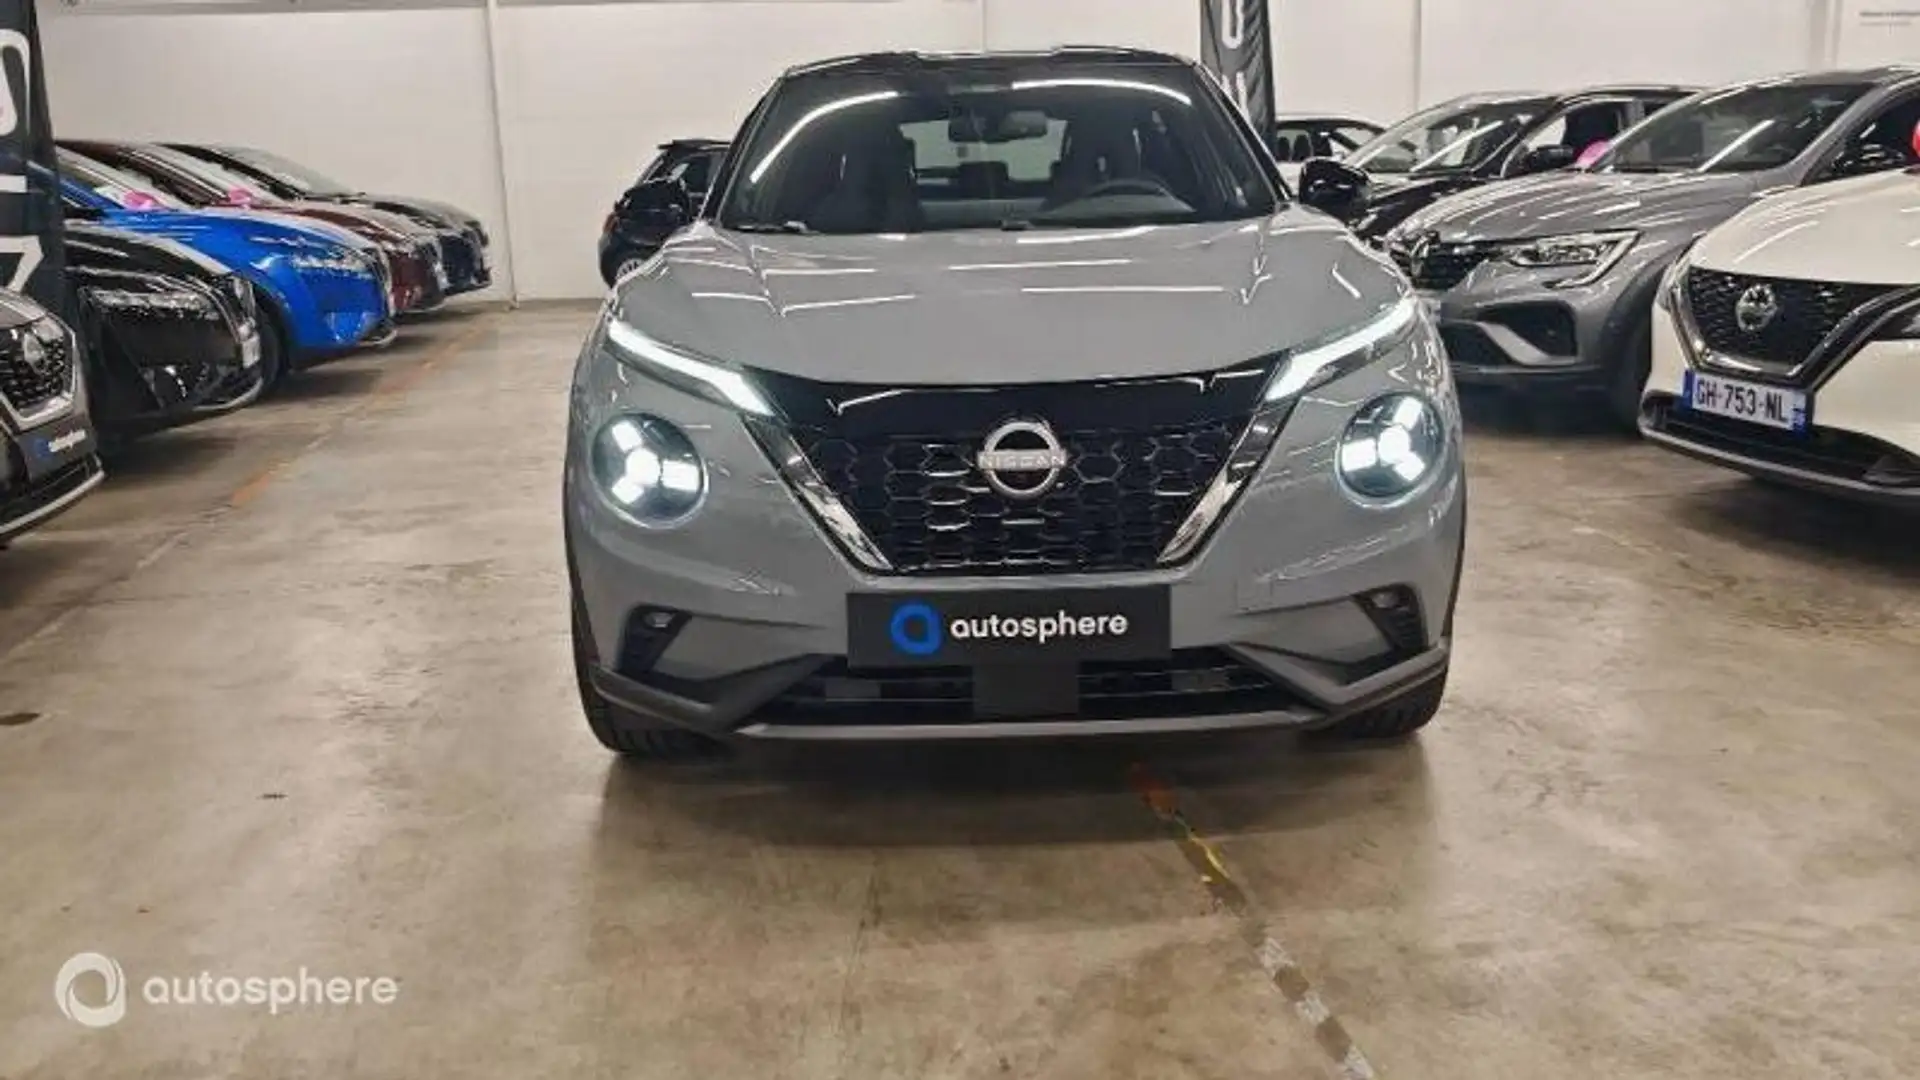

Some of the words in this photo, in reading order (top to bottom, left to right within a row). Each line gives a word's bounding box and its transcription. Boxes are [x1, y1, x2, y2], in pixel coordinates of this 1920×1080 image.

[1696, 379, 1789, 423] GH-753-NL
[978, 454, 1065, 470] NISSAN
[951, 610, 1128, 643] autosphere
